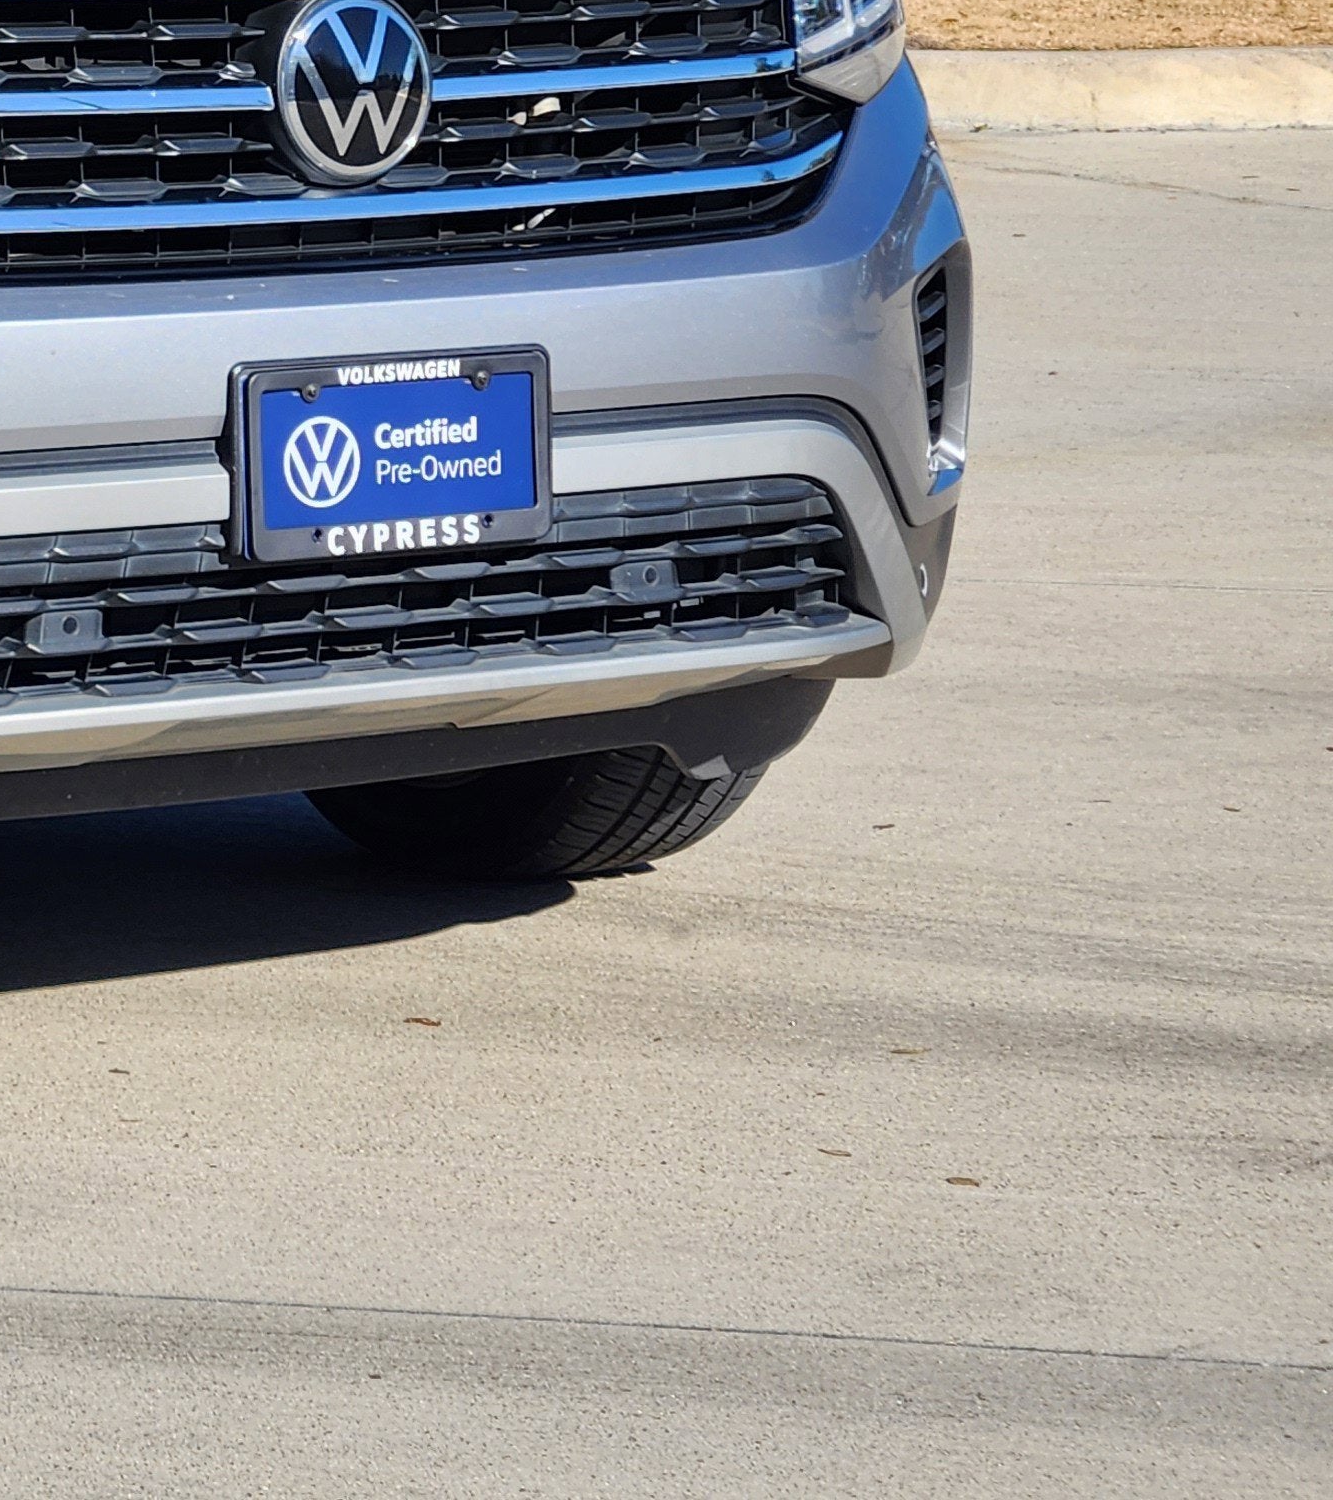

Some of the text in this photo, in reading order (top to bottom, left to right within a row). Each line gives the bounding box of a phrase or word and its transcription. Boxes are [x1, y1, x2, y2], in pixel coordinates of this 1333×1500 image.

[338, 359, 461, 386] VOLKSWAGEN
[374, 416, 478, 450] Certified
[284, 415, 361, 508] VW
[375, 449, 502, 485] Pre-Owned
[327, 514, 481, 556] CYPRESS
